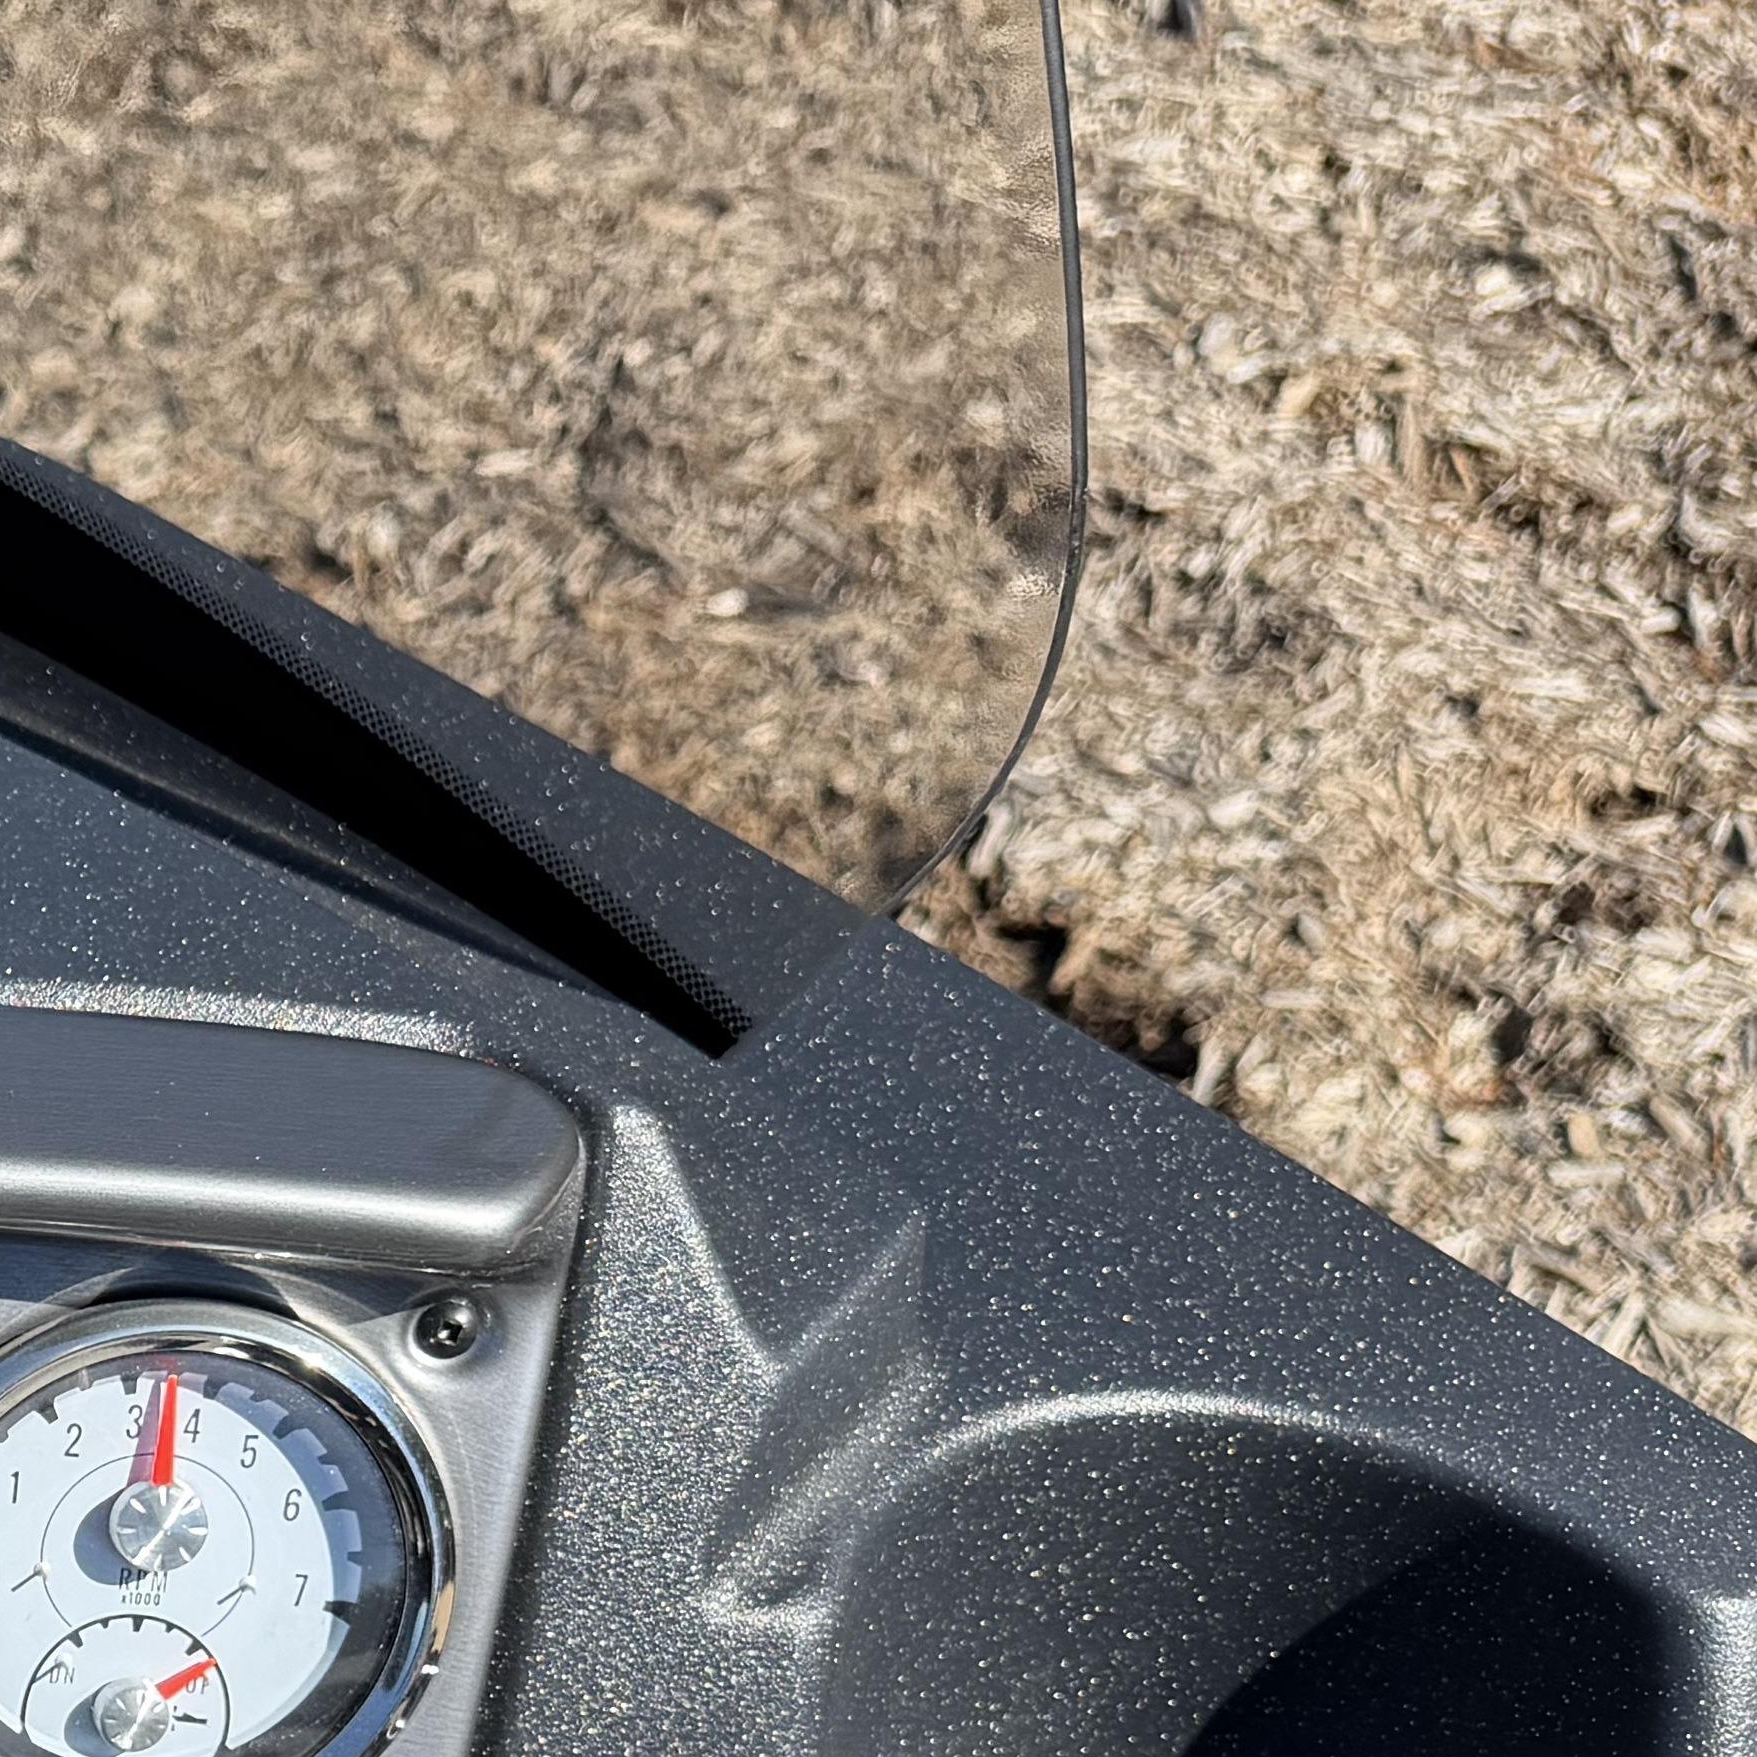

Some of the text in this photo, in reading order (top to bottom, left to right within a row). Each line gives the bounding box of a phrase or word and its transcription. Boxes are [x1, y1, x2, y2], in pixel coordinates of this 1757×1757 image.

[127, 1405, 143, 1438] 3
[184, 1409, 201, 1443] 4
[65, 1424, 82, 1457] 2
[241, 1435, 259, 1468] 5
[11, 1472, 19, 1503] 1
[284, 1488, 302, 1521] 6
[119, 1567, 167, 1592] RPM
[294, 1574, 308, 1607] 7
[121, 1593, 160, 1606] x1000
